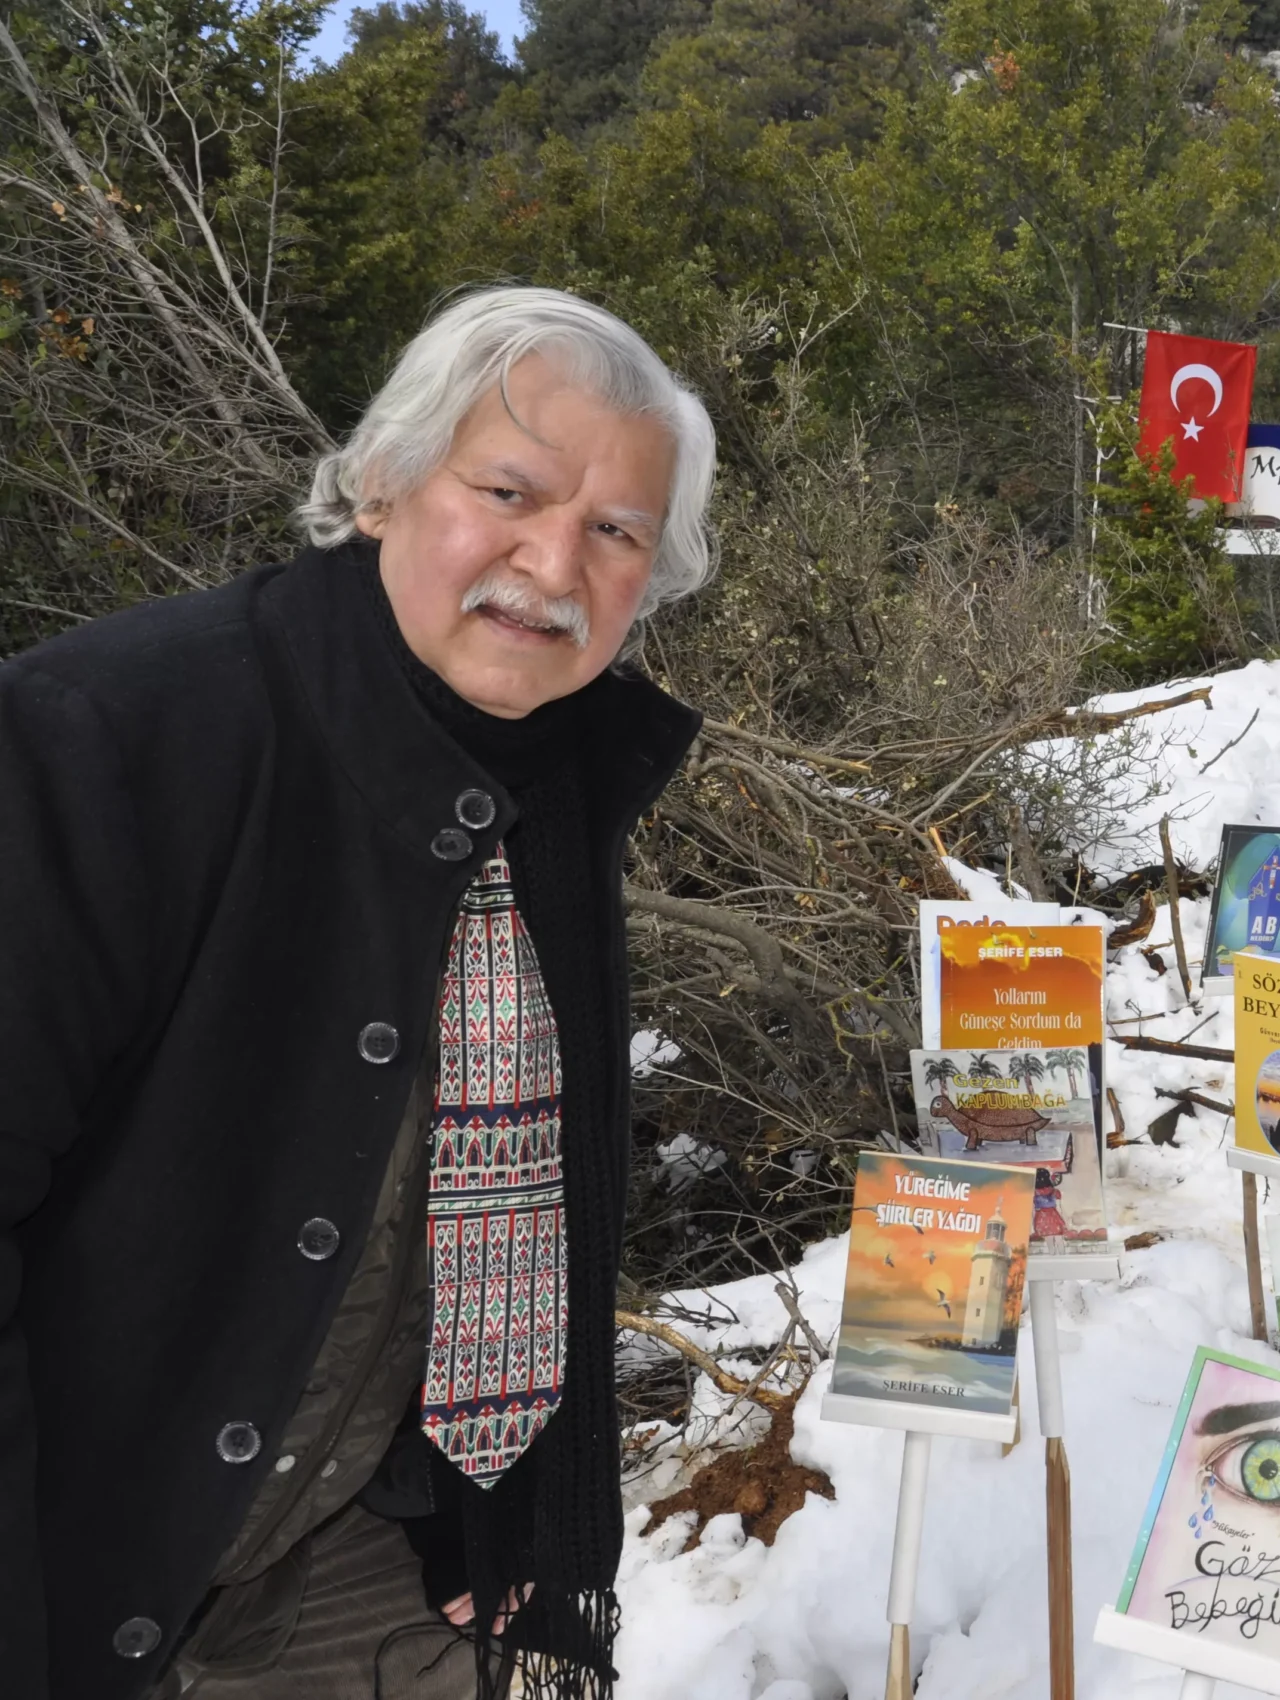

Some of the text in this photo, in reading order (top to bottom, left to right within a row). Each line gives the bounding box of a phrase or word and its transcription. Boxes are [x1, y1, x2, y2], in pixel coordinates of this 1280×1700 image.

[977, 945, 1063, 960] ŞERİFE ESER
[994, 988, 1047, 1005] Yollarını
[959, 1012, 1082, 1031] Güneşe Sordum da
[953, 1073, 1020, 1089] Gezen
[956, 1089, 1067, 1109] KAPLUMBAĞA
[895, 1170, 971, 1202] YÜREĞİME
[876, 1199, 982, 1234] ŞİİRLER YAĞDI
[882, 1379, 965, 1398] ŞERİFE ESER
